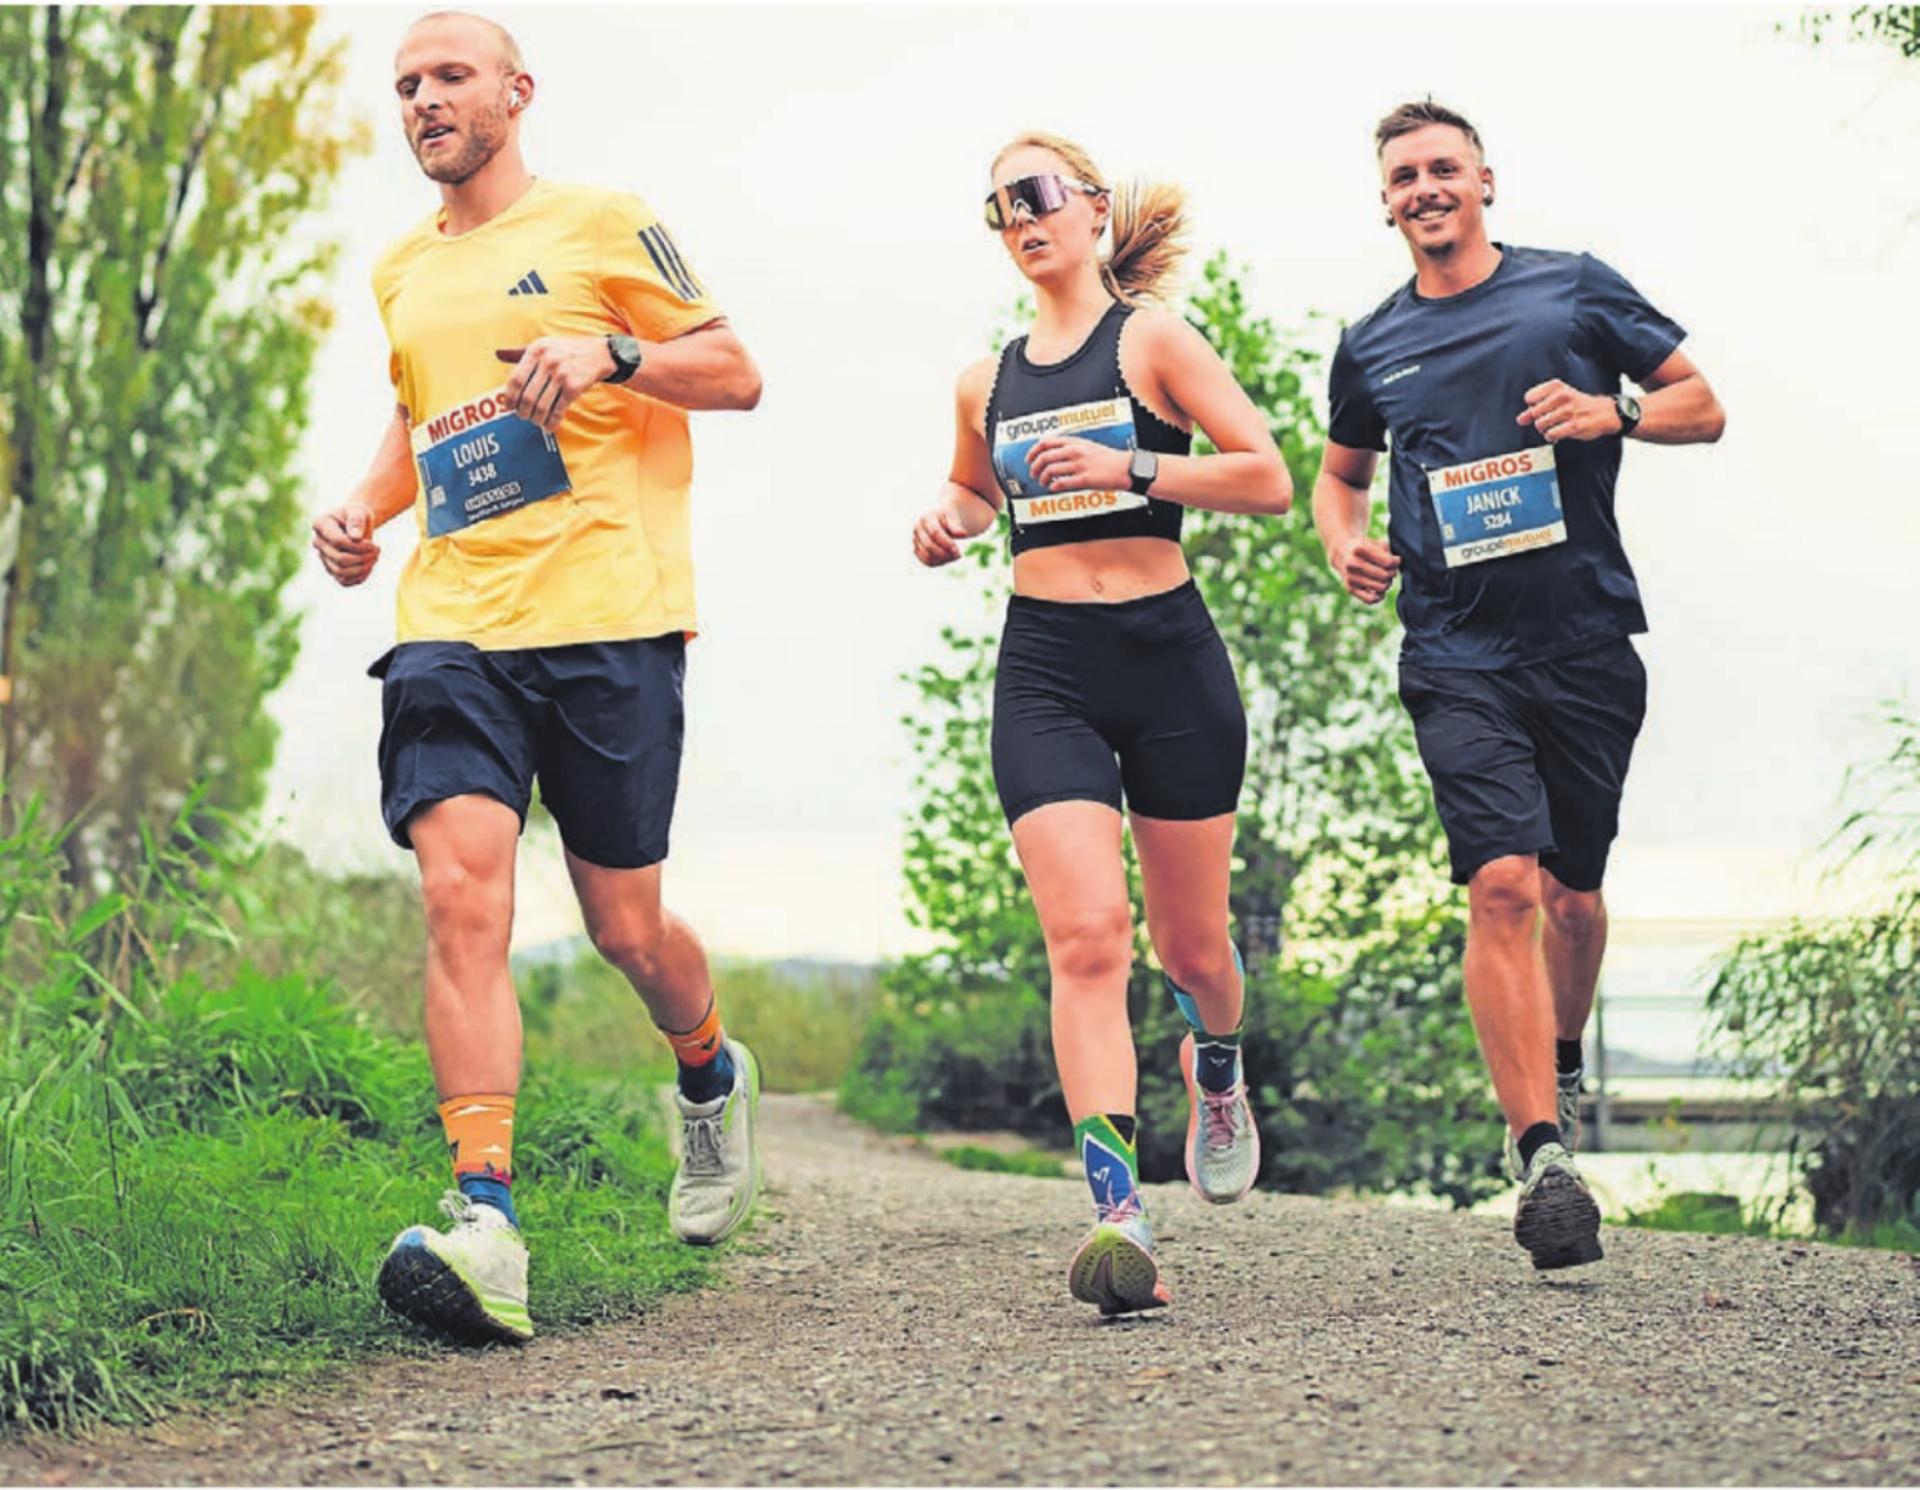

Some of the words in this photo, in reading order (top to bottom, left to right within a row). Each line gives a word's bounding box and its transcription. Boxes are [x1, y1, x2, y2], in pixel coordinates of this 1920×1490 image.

[427, 393, 507, 443] MIGROS
[453, 433, 500, 468] LOUIS
[468, 463, 497, 487] 3438
[1444, 454, 1533, 487] MIGROS
[1030, 490, 1118, 517] MIGROS
[1466, 486, 1522, 515] JANICK
[1483, 512, 1512, 530] 5284
